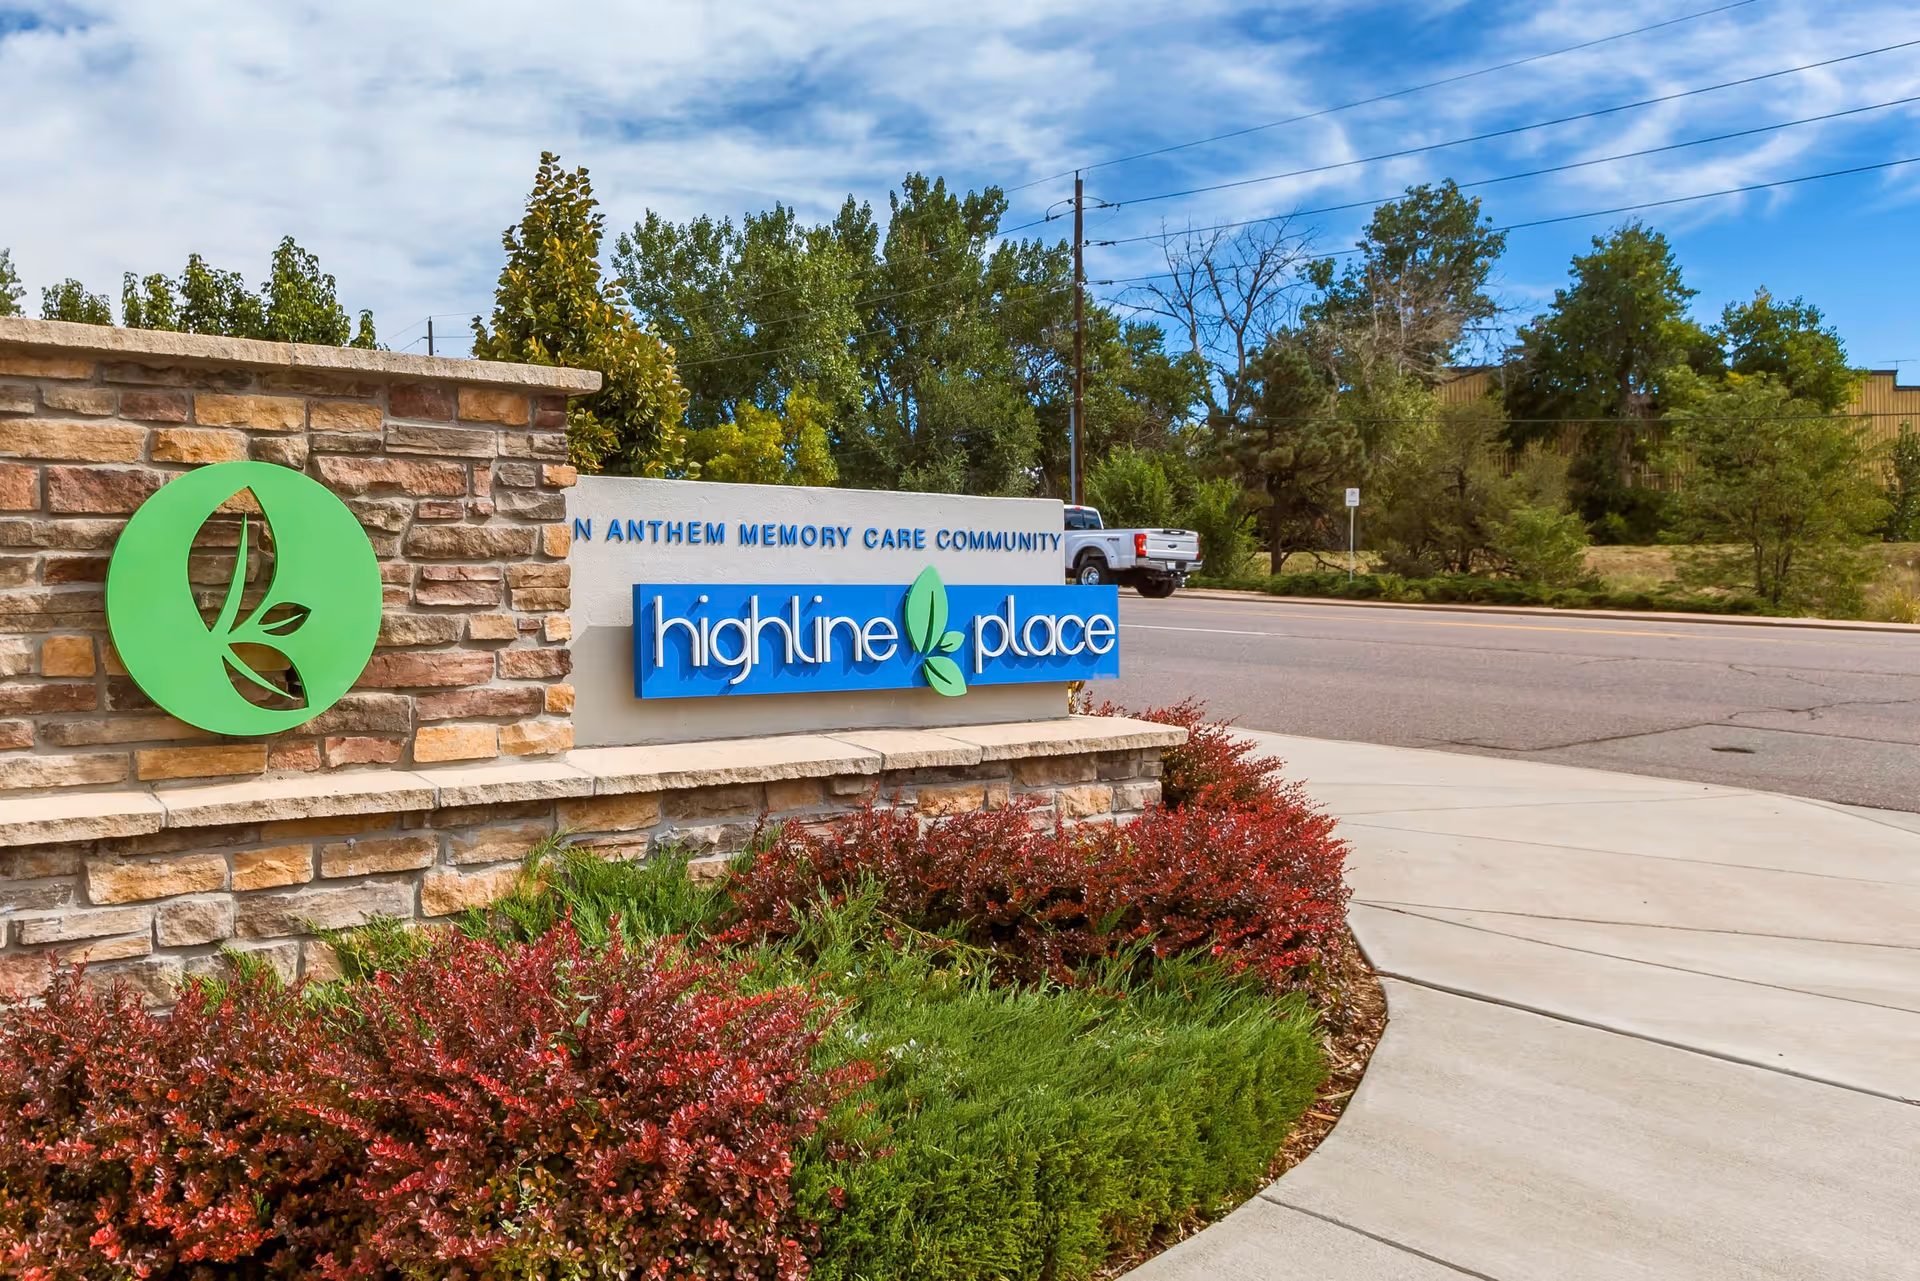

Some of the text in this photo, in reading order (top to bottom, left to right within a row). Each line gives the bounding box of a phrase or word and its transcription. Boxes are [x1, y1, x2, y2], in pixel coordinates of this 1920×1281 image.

[568, 517, 1062, 552] N ANTHEM MEMORY CARE COMMUNITY
[653, 594, 1117, 684] highline place
